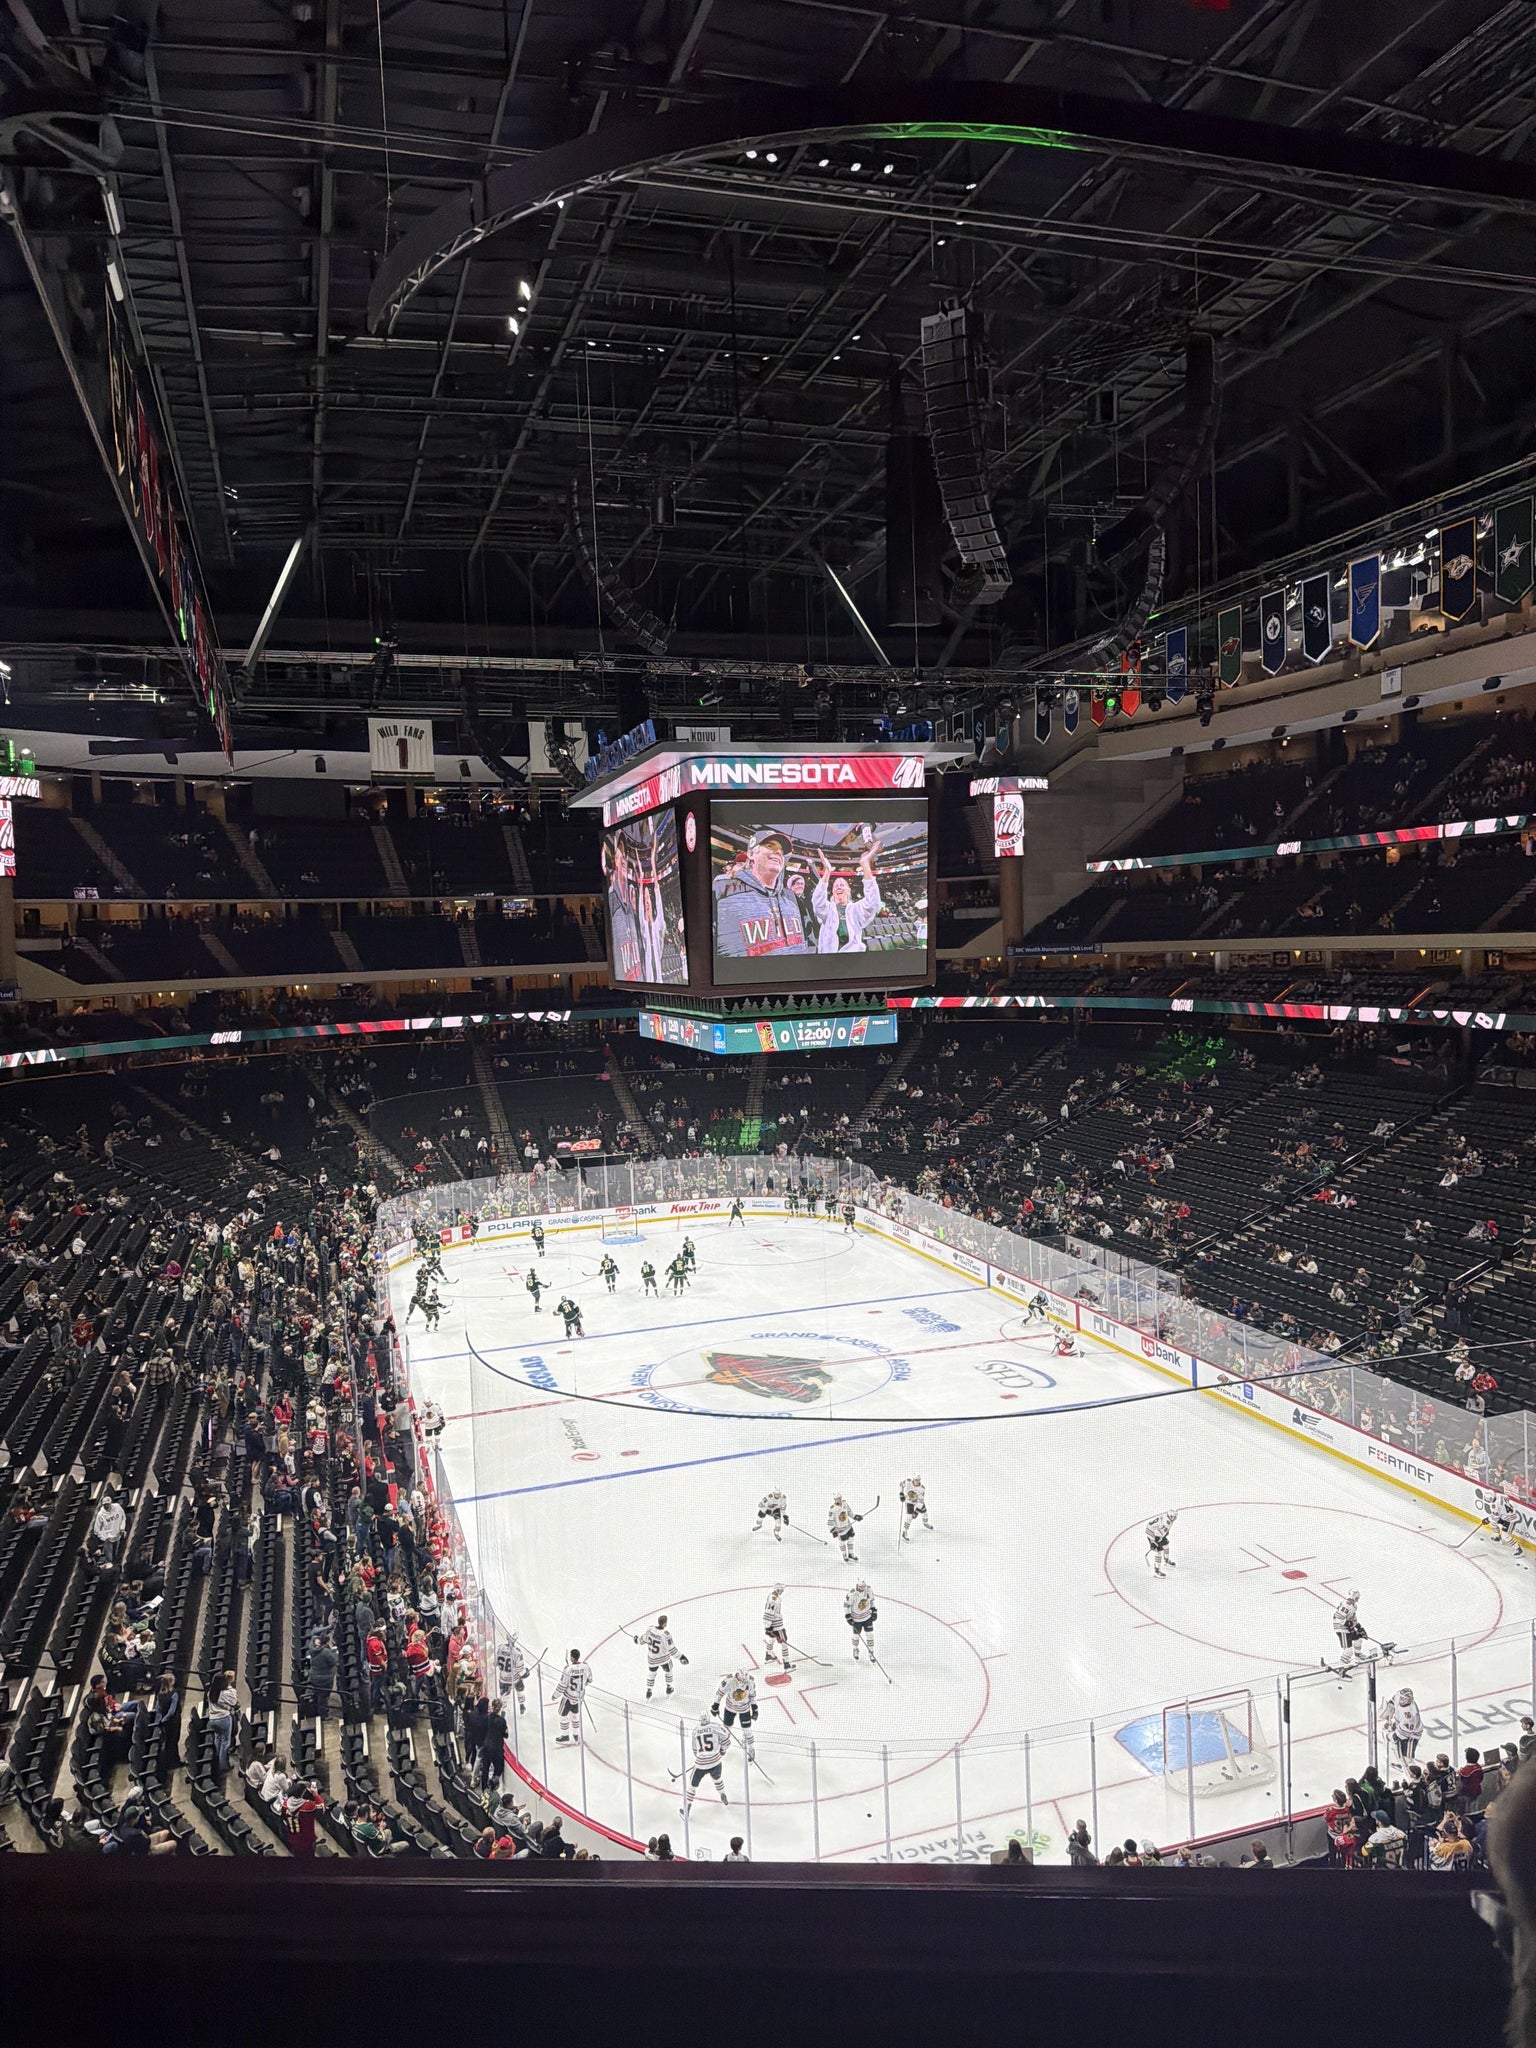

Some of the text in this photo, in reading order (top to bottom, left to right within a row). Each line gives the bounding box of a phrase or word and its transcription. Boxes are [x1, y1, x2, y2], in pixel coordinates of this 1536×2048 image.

[377, 725, 425, 740] WILD FANS
[691, 728, 716, 742] KOIVU
[395, 738, 408, 769] 1
[691, 763, 857, 785] MINNESOTA
[616, 787, 652, 818] MINNESOTA
[1041, 946, 1070, 954] Management
[1081, 944, 1094, 952] Level
[780, 1030, 790, 1043] 0
[797, 1027, 831, 1041] 12:00
[837, 1027, 847, 1040] 0
[631, 1206, 657, 1215] bank
[670, 1201, 721, 1214] KWIK TRIP
[488, 1218, 543, 1232] POLARIS
[548, 1213, 603, 1226] GRAND CASINO
[835, 1335, 892, 1354] CASINO
[1142, 1340, 1181, 1367] us bank
[631, 1363, 658, 1387] ARENA
[891, 1358, 913, 1382] ARENA
[975, 1362, 1034, 1389] CHS
[1368, 1446, 1434, 1483] FORTINET
[570, 1674, 584, 1692] 51
[696, 1733, 714, 1752] 15
